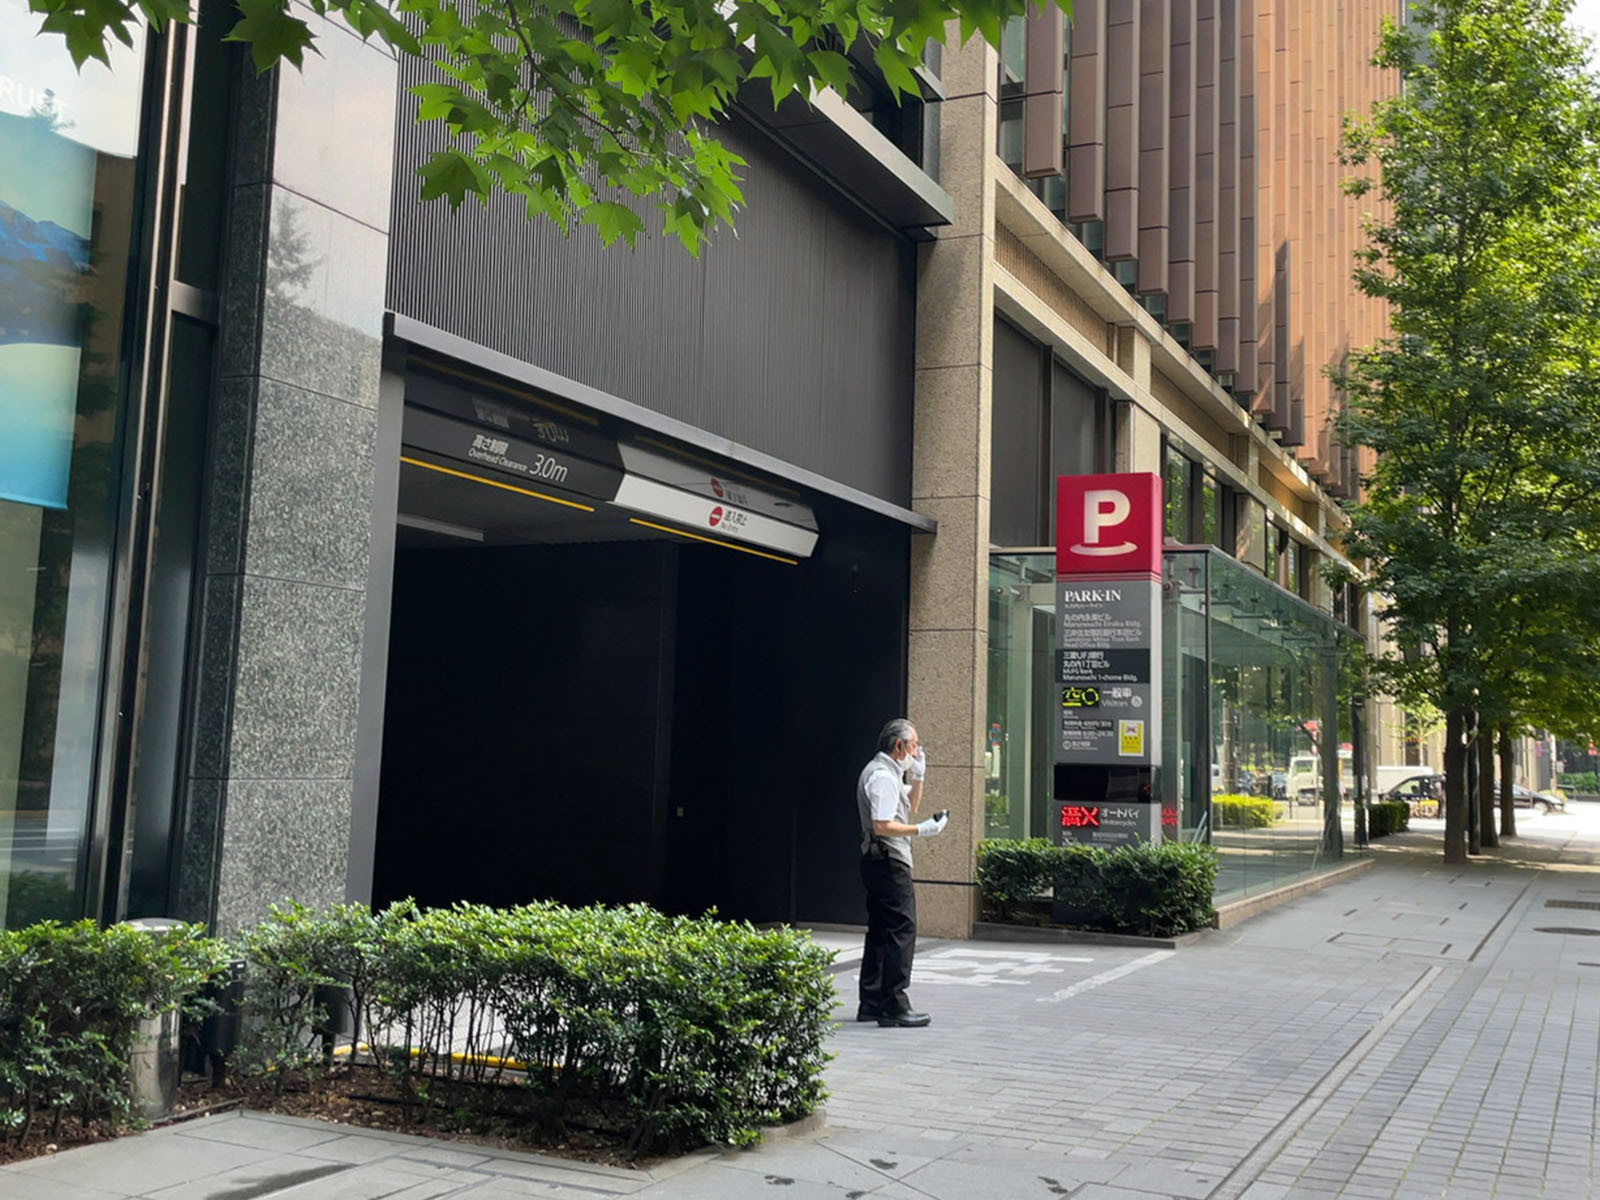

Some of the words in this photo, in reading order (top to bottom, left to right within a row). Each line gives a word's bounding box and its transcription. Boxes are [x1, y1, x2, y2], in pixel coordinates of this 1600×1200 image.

[468, 448, 500, 464] Overhead
[498, 456, 528, 471] Clearance
[1083, 490, 1131, 544] P
[1100, 807, 1140, 818] オートバイ
